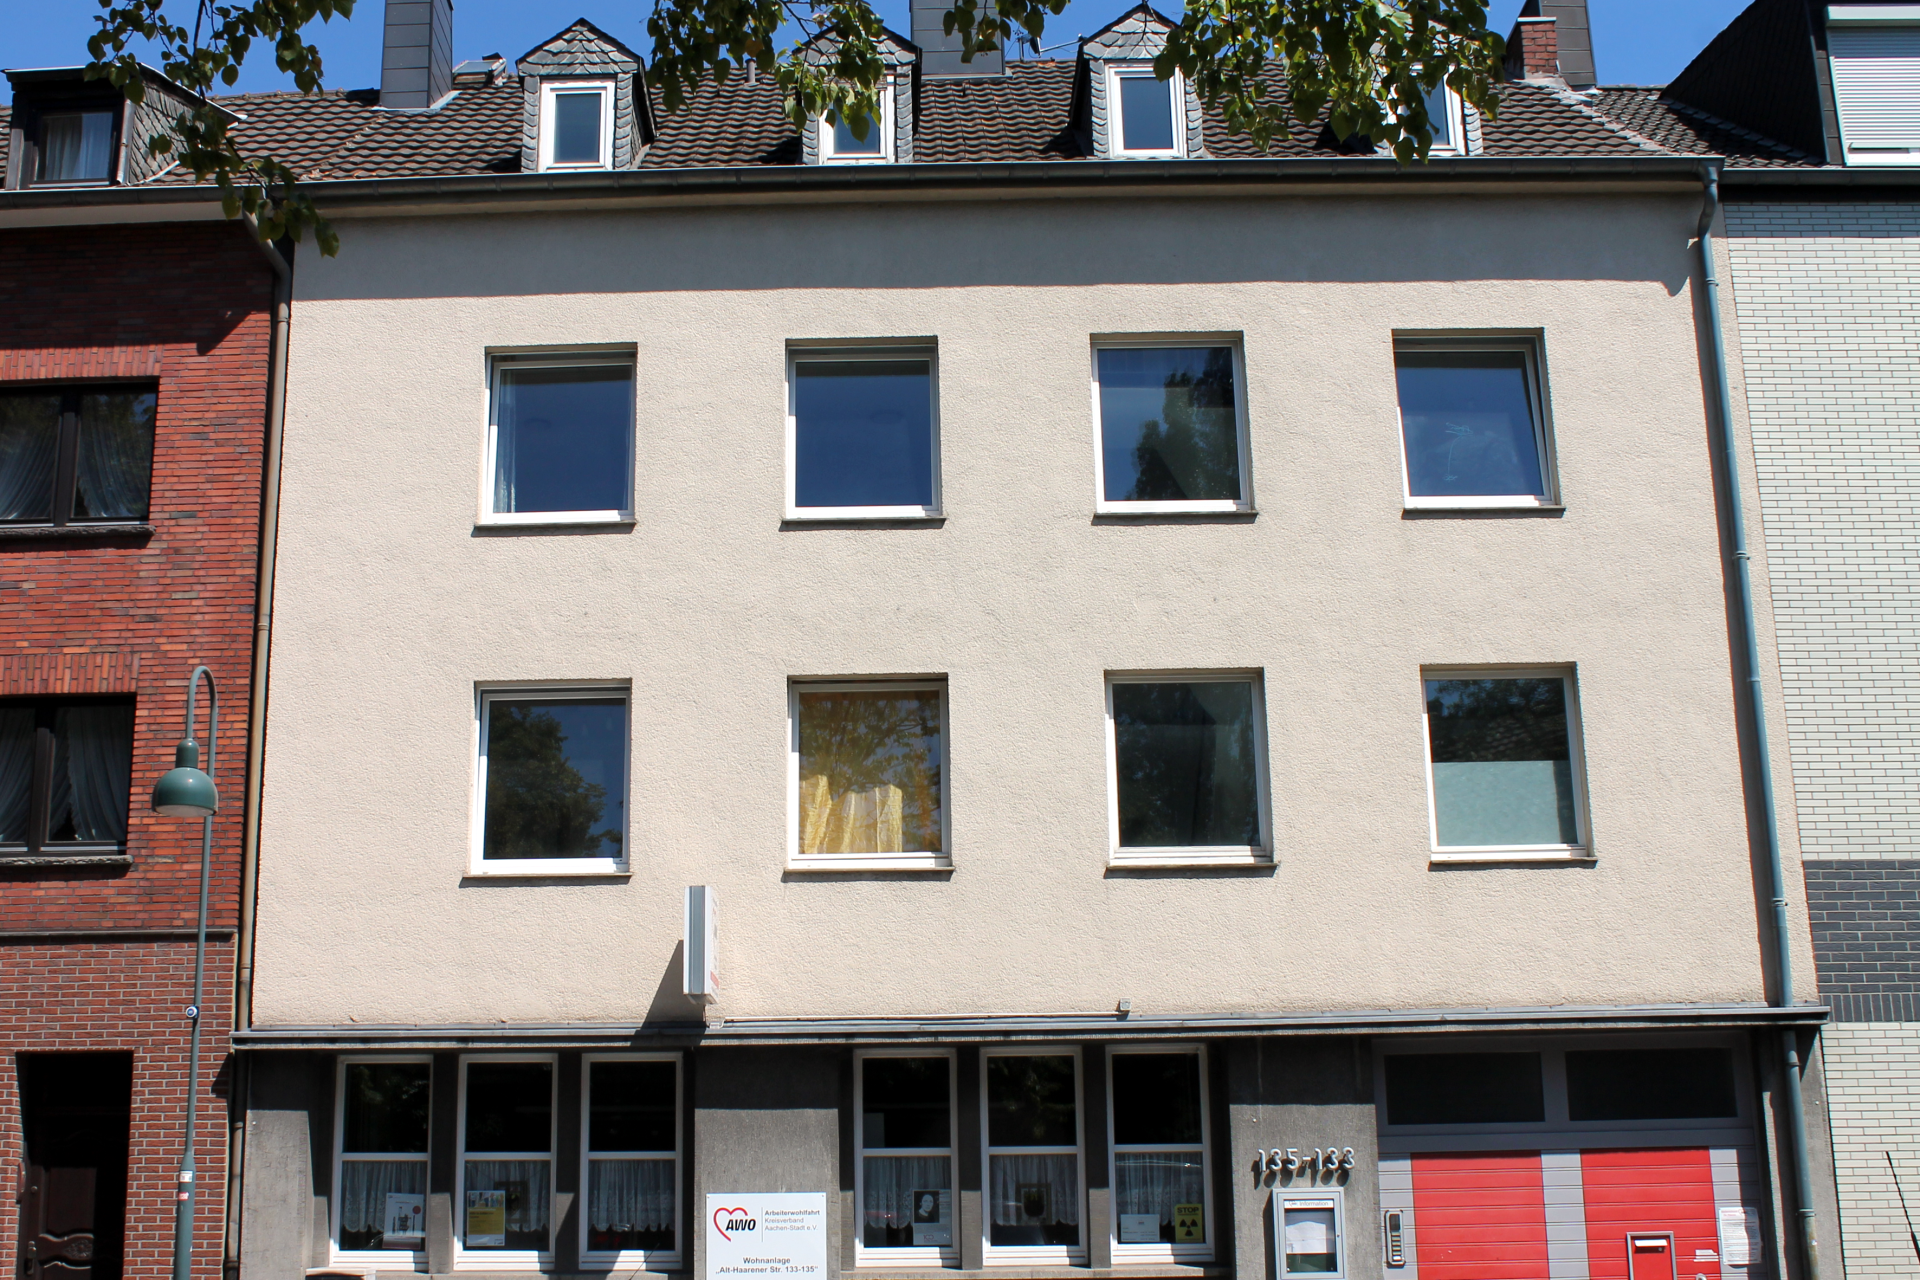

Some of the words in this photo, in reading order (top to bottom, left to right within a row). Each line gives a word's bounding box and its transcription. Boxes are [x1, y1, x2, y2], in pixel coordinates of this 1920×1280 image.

[1258, 1147, 1355, 1171] 135-133
[726, 1219, 756, 1231] AWO
[743, 1257, 791, 1265] Wohnanlage
